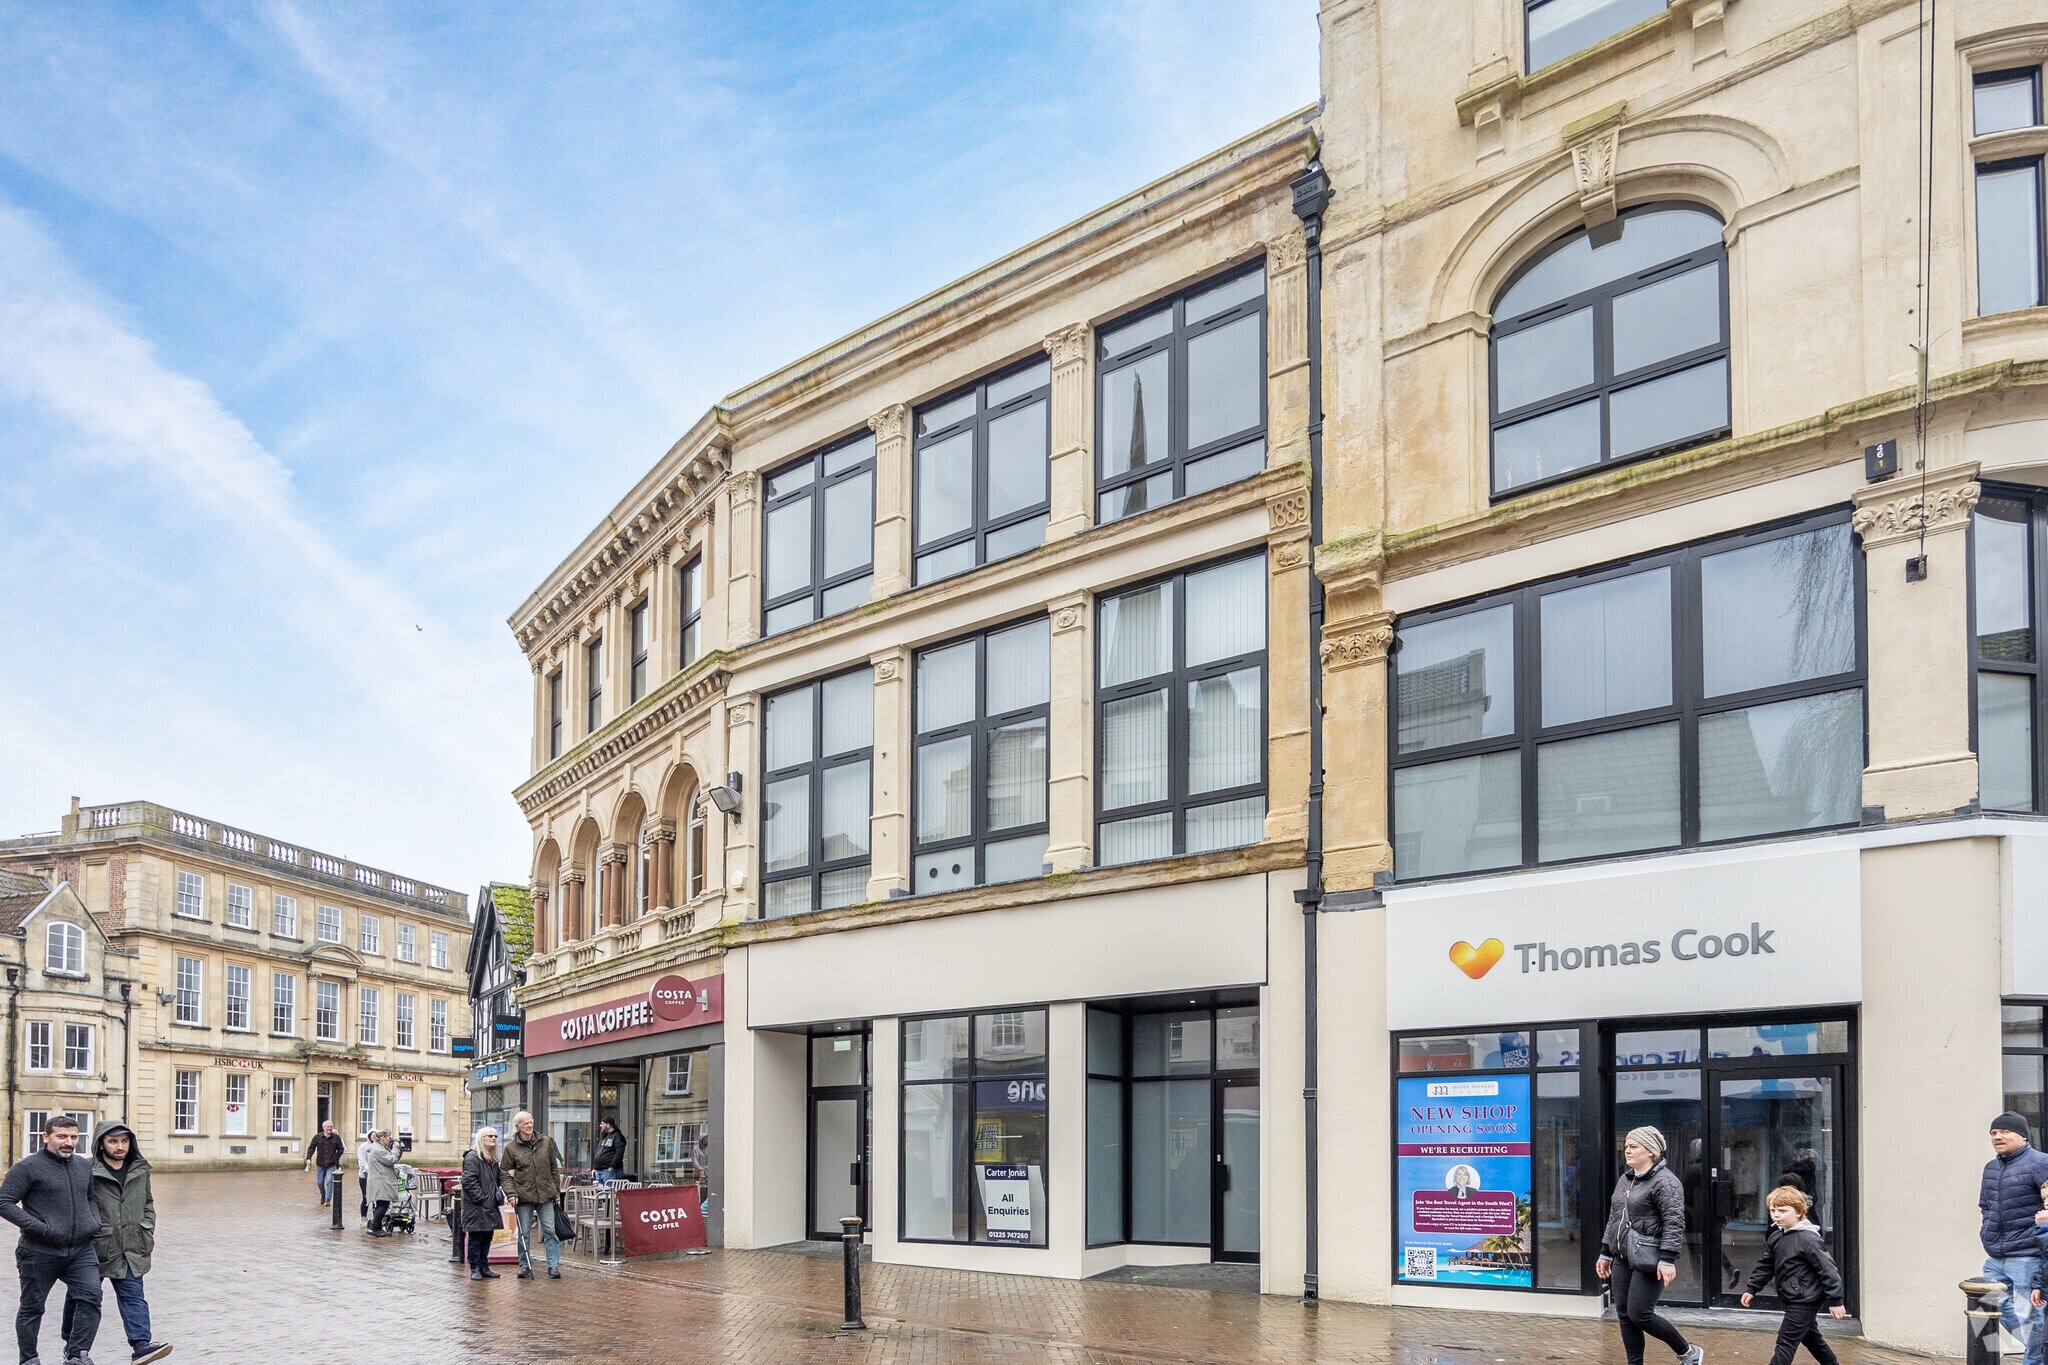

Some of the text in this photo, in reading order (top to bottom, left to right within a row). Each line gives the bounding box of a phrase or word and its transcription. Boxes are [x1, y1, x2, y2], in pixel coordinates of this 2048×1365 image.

[1513, 922, 1776, 973] Thomas Cook
[656, 989, 692, 1000] COSTA
[561, 1001, 648, 1040] COSTA COFFEE
[214, 1057, 264, 1069] HSBC UK
[387, 1072, 424, 1082] HSBC UK
[1411, 1104, 1517, 1120] NEW SHOP
[1411, 1123, 1517, 1134] OPENING SOON
[1420, 1146, 1508, 1154] WE'RE RECRUITING
[986, 1168, 1027, 1179] Carter Jonas
[1002, 1193, 1014, 1203] All
[640, 1207, 688, 1223] COSTA
[988, 1206, 1030, 1217] Enquiries
[652, 1222, 680, 1230] COFFEE
